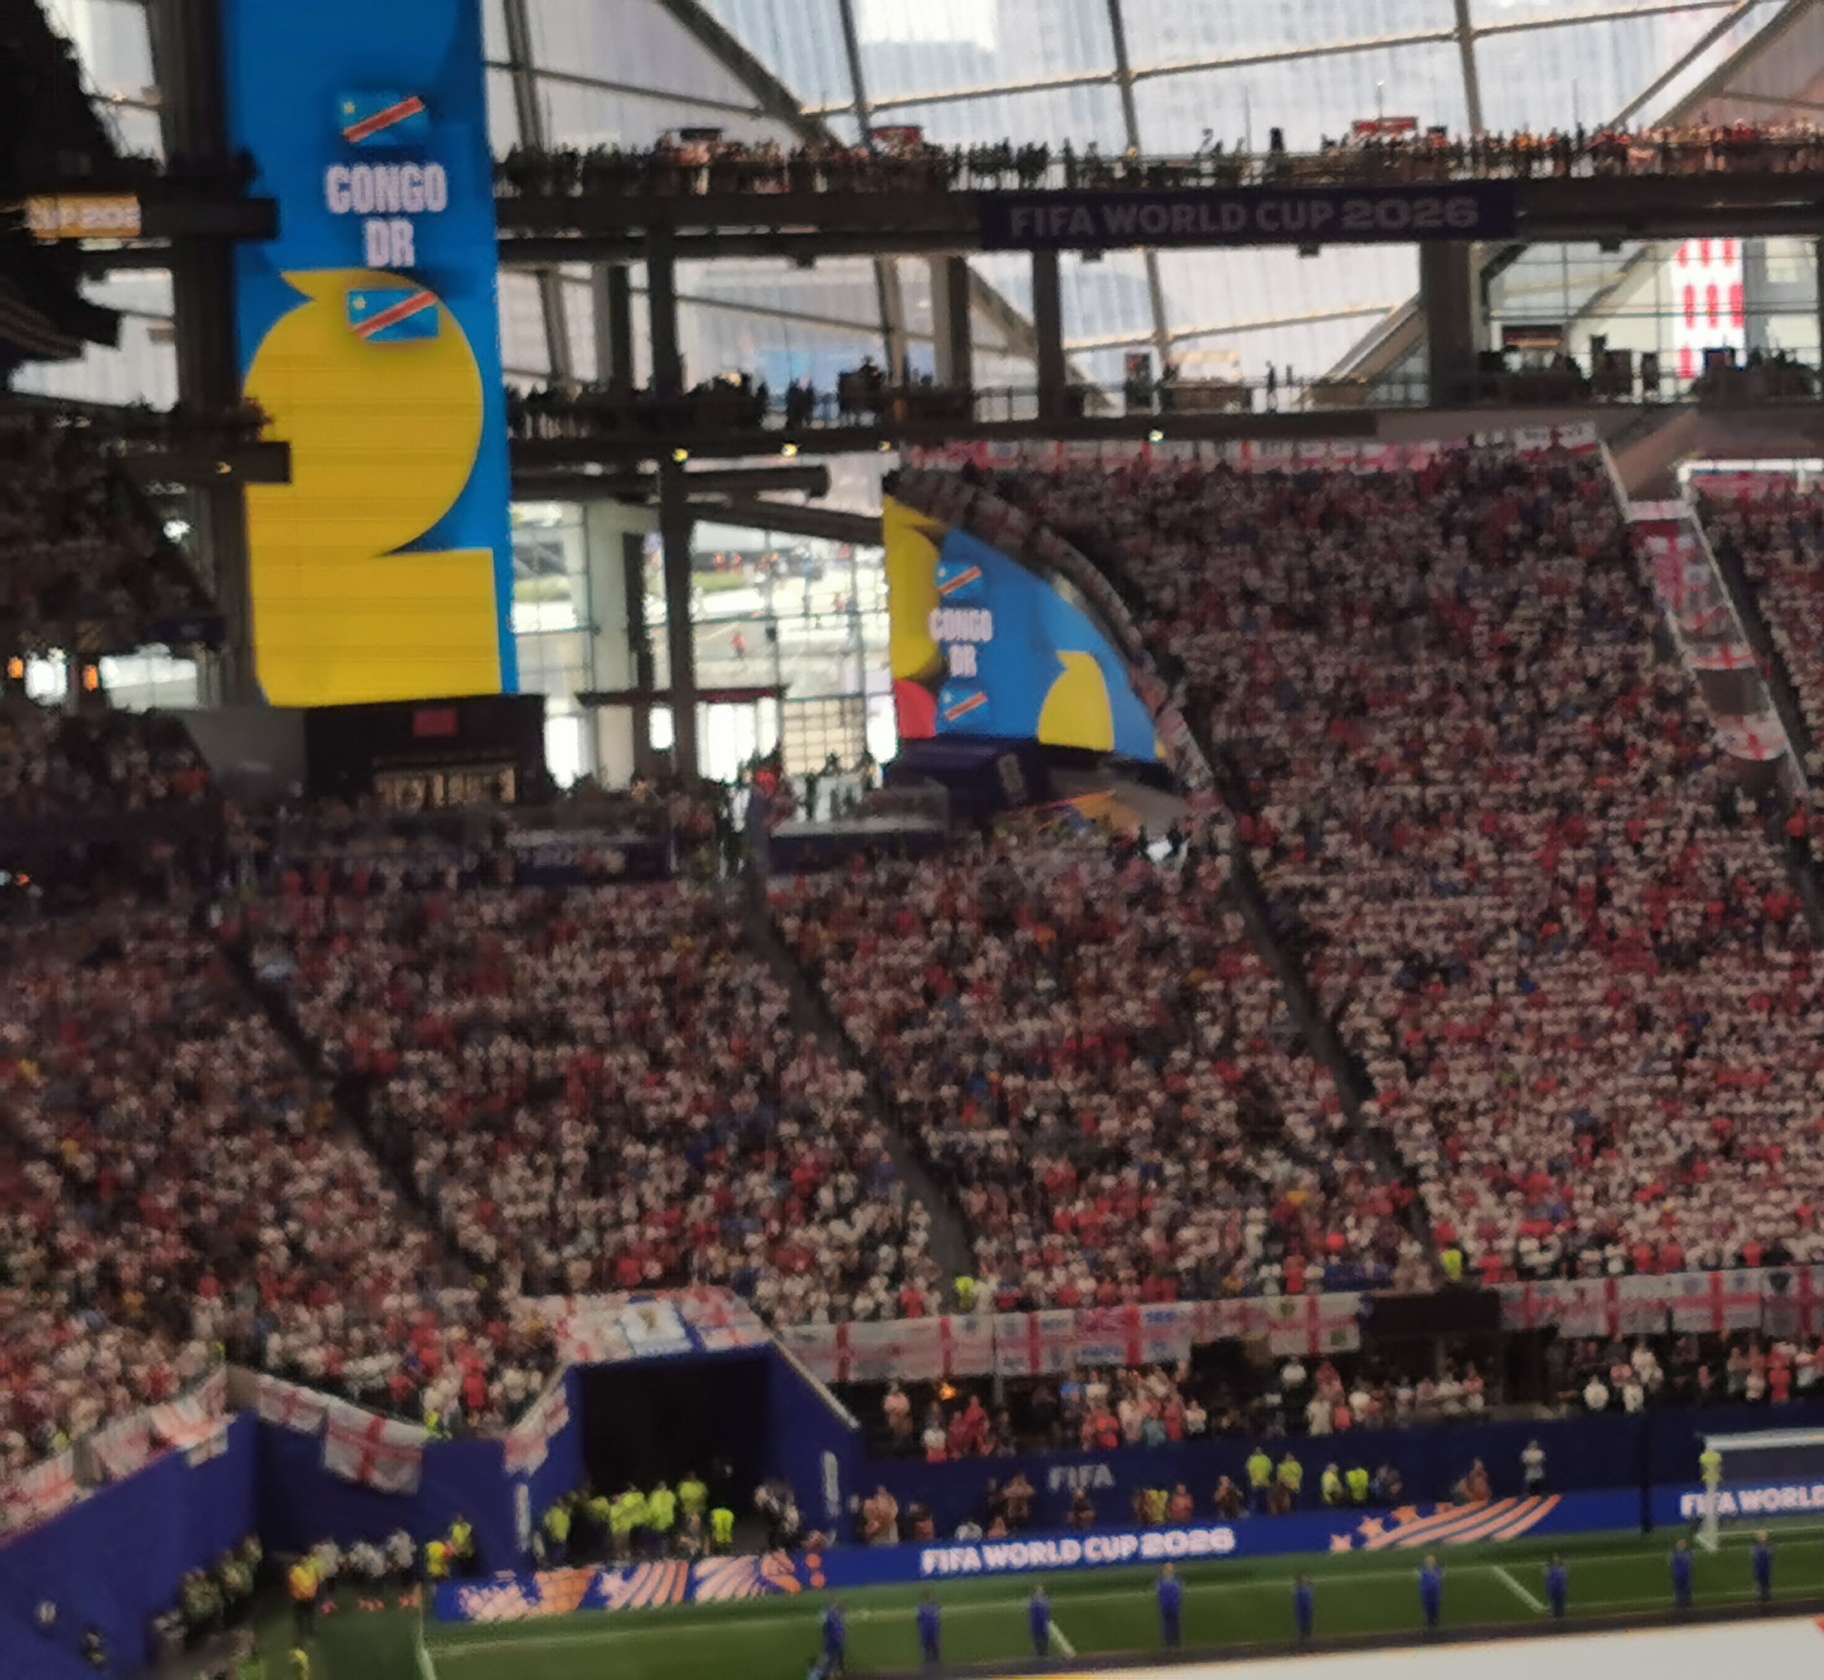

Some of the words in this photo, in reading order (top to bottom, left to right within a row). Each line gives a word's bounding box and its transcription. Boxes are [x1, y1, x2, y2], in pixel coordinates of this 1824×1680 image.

[326, 162, 448, 214] CONGO
[1010, 206, 1095, 237] FIFA
[1101, 202, 1249, 235] WORLD
[1255, 200, 1334, 232] CUP
[1342, 197, 1479, 228] 2026
[365, 217, 415, 267] DR
[927, 607, 993, 643] CONGO
[949, 645, 978, 677] DR
[1048, 1463, 1116, 1493] FIFA
[921, 1547, 982, 1576] FIFA
[982, 1539, 1081, 1570] WORLD
[1084, 1535, 1138, 1562] CUP
[1140, 1527, 1236, 1557] 2026
